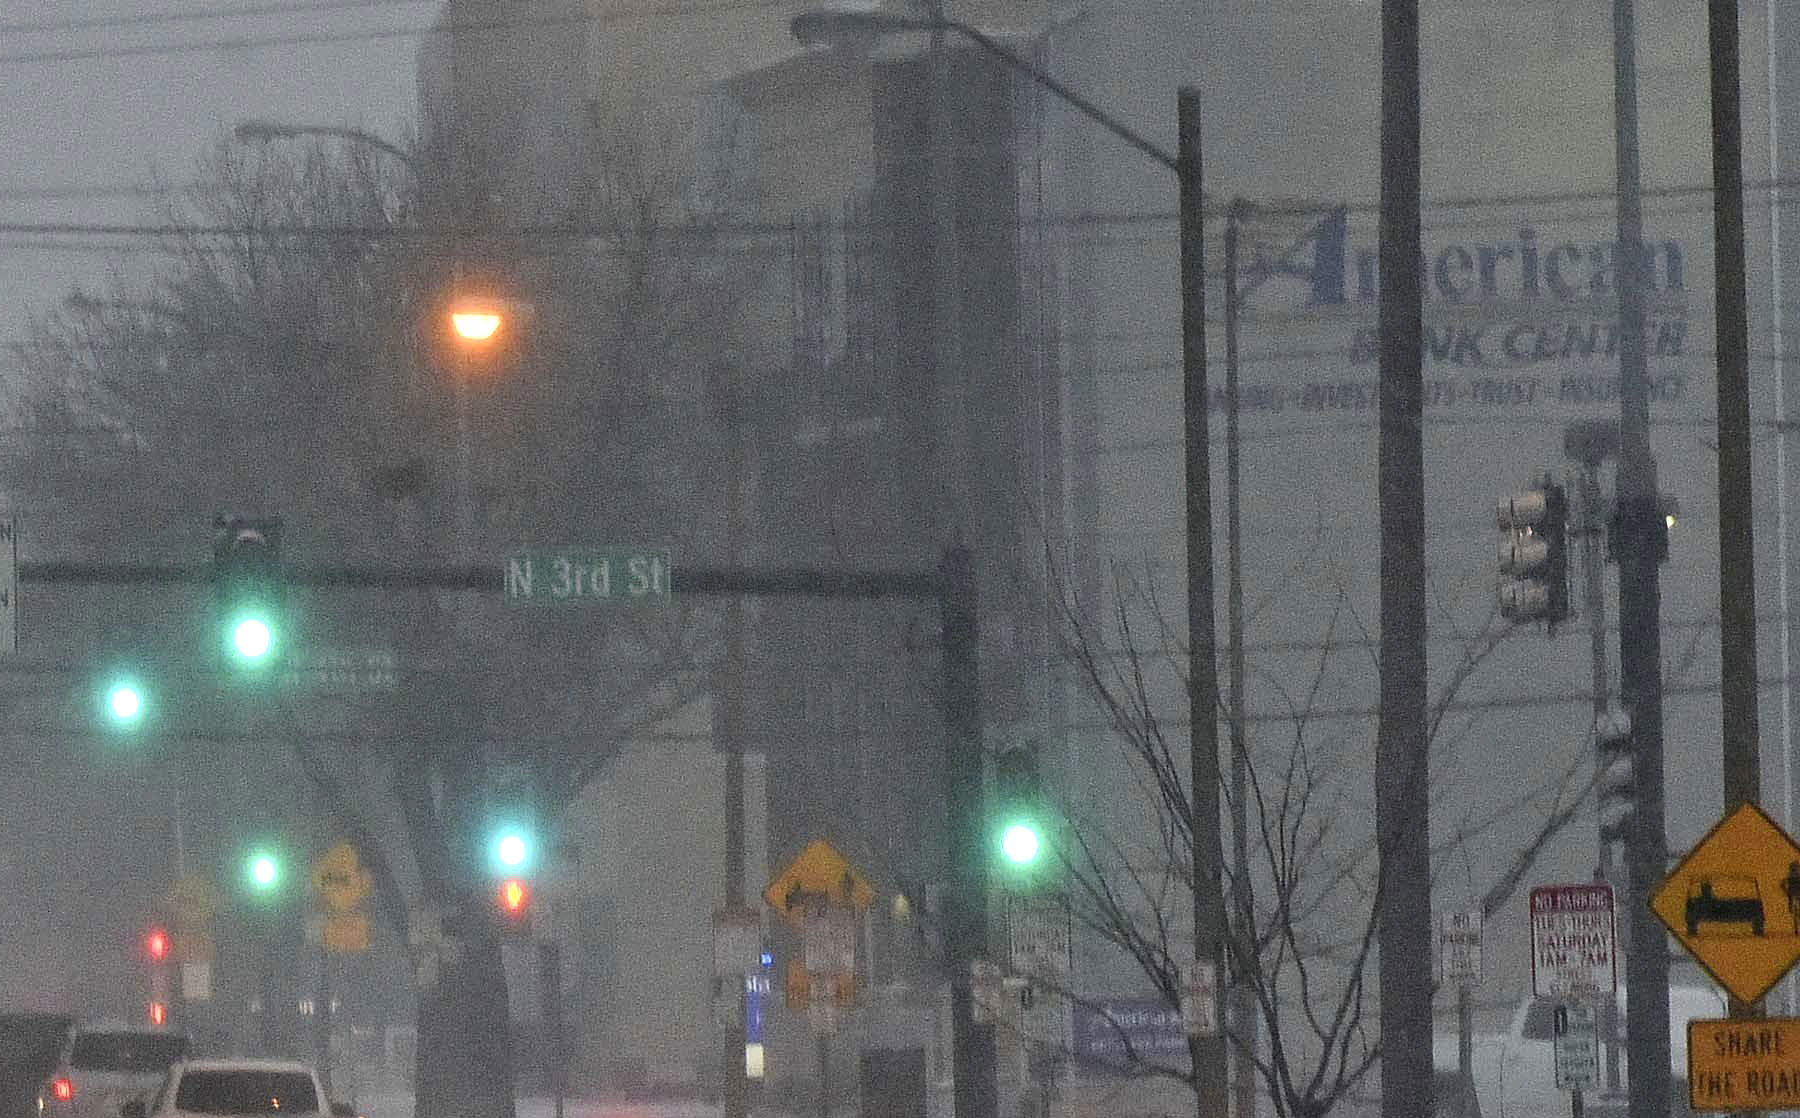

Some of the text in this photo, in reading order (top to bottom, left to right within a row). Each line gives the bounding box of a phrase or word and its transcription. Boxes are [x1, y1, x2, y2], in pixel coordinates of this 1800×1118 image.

[1348, 321, 1484, 368] BNK
[1558, 373, 1687, 405] INSURNCE
[508, 555, 664, 598] N 3rd St
[1534, 893, 1553, 911] NO
[1713, 1029, 1786, 1057] SHARE
[1697, 1069, 1736, 1099] THE
